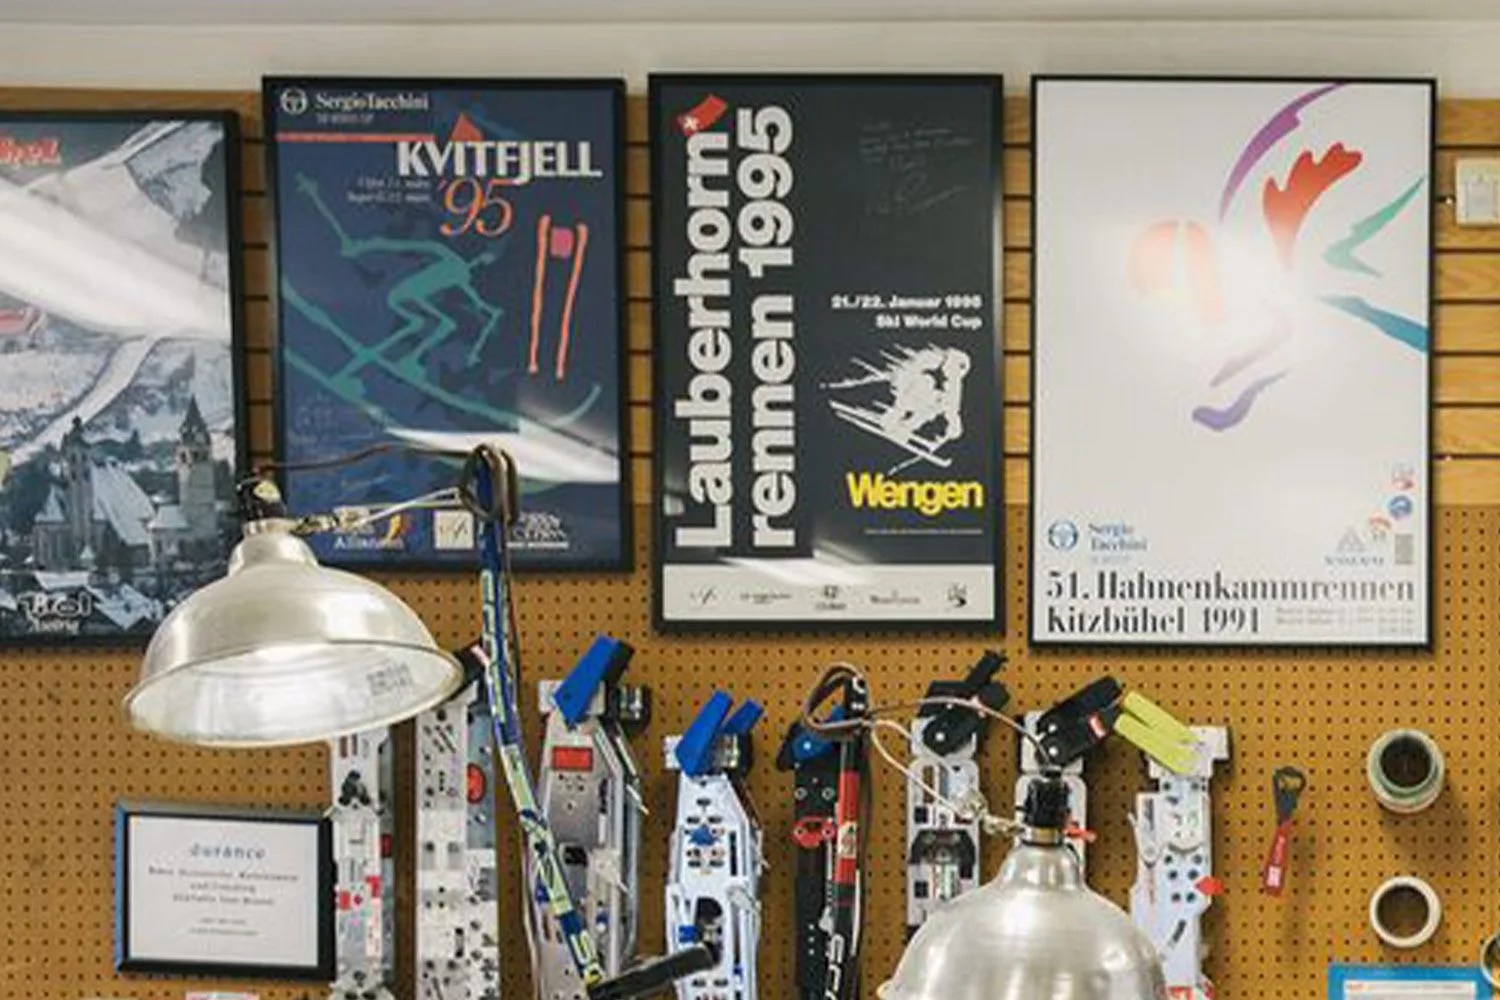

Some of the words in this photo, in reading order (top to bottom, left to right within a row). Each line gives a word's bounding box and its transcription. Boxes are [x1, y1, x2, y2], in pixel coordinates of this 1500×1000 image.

[398, 141, 603, 185] KVITFJELL
[737, 105, 794, 279] 1995
[674, 132, 732, 548] Lauberhorn
[902, 314, 949, 329] World
[951, 314, 983, 331] Cup
[751, 294, 796, 548] rennen
[846, 472, 984, 515] Wengen
[1046, 570, 1090, 600] 51.
[1097, 570, 1414, 601] Hahnenkammrennen
[1046, 605, 1185, 634] Kitzbühel
[1202, 606, 1260, 634] 1991
